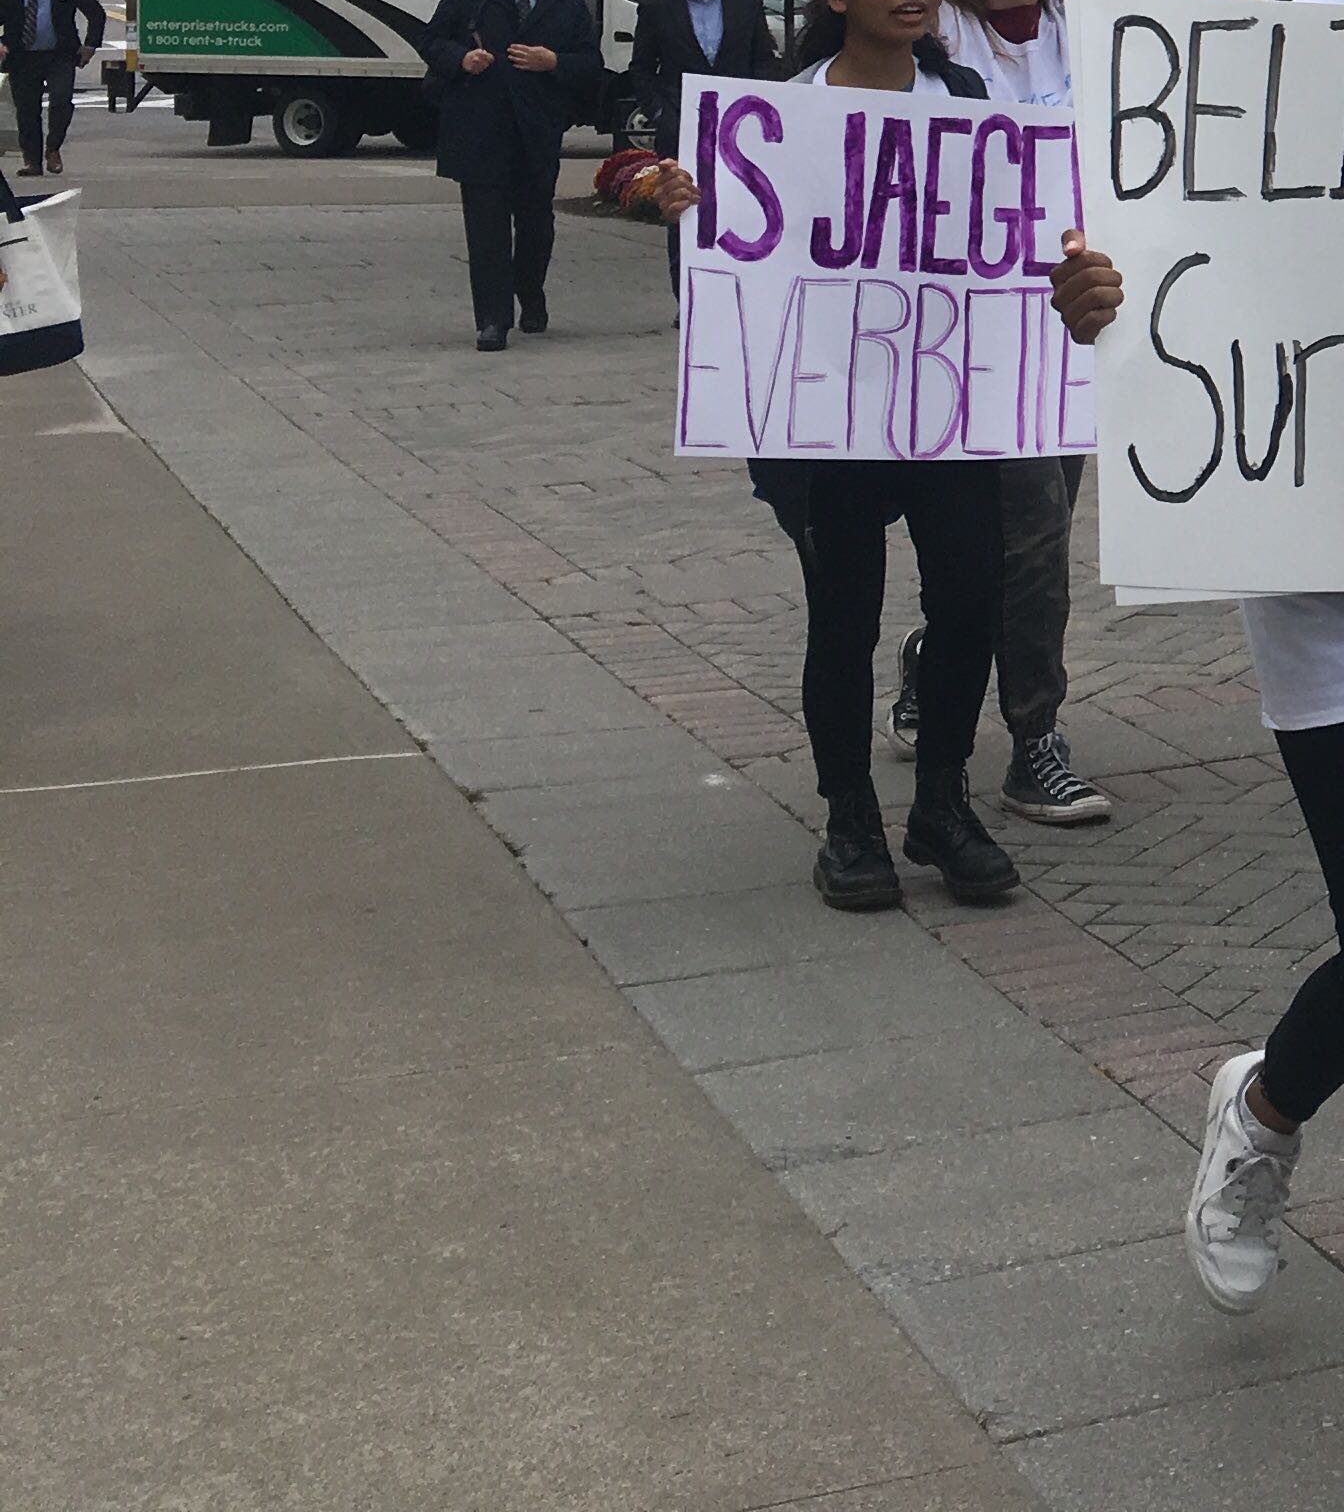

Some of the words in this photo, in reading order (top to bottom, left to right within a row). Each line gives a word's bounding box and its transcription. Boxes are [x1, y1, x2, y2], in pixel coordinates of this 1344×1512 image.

[146, 19, 289, 32] enterprisetrucks.com
[156, 35, 180, 45] 800
[183, 35, 263, 47] rent-a-truck
[695, 90, 785, 263] IS
[809, 110, 1086, 281] JAEGE
[680, 266, 1098, 461] EVERBETTE
